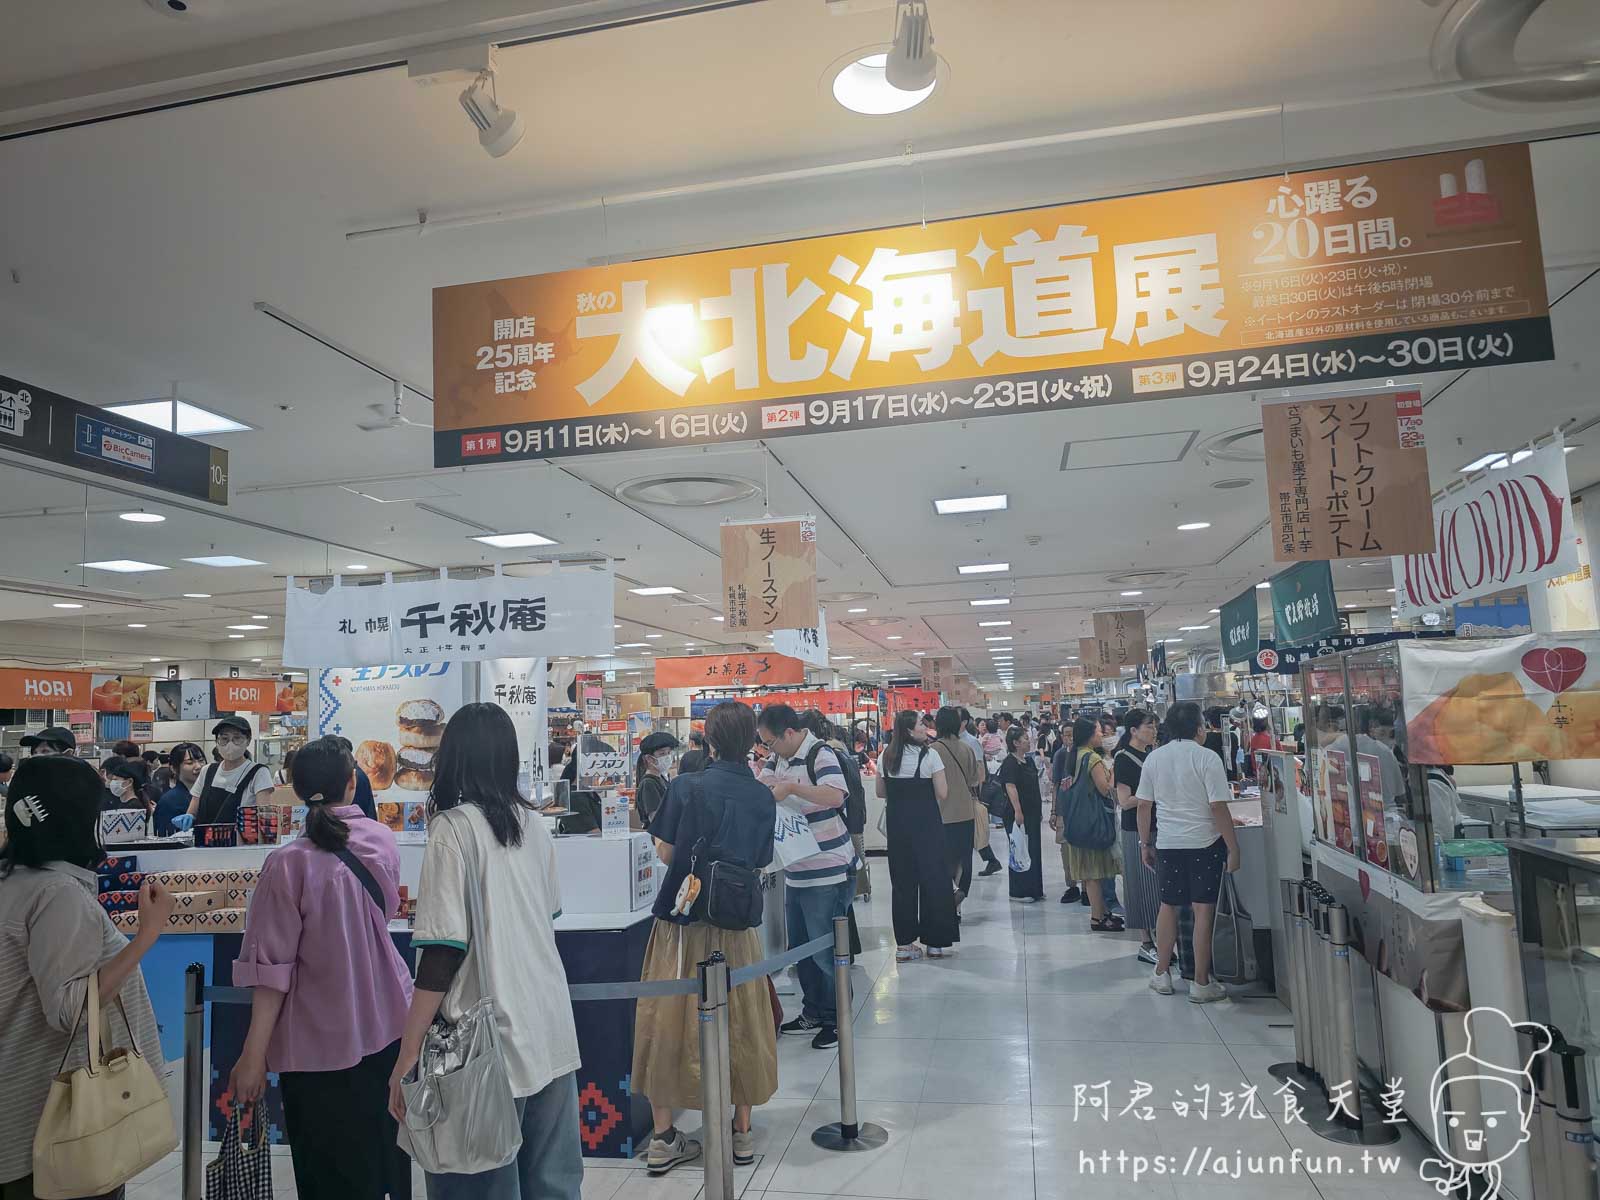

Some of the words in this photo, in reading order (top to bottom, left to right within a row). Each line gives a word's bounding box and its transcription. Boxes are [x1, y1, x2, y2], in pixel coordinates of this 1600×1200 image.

[1267, 175, 1378, 219] 心躍る
[1253, 216, 1412, 264] 20日間。
[576, 290, 617, 312] 秋の
[575, 223, 1229, 406] 大北海道展
[494, 316, 536, 340] 開店
[476, 341, 556, 370] 25周年
[494, 371, 537, 394] 記念
[1138, 369, 1178, 387] 第3弾
[766, 408, 800, 425] 第2弾
[465, 438, 497, 453] 第1弾
[210, 464, 227, 486] 10F
[1288, 404, 1310, 523] さつまいも菓子専門店
[1320, 404, 1352, 556] スイートポテト
[1349, 402, 1382, 551] ソフトクリーム
[759, 528, 778, 625] 生ノースマン
[338, 616, 389, 634] 札幌
[400, 596, 546, 639] 千秋庵
[168, 668, 177, 679] P
[25, 679, 73, 697] HORI
[229, 687, 260, 701] HORI
[494, 684, 537, 704] 千秋庵
[588, 759, 625, 769] ノースマン
